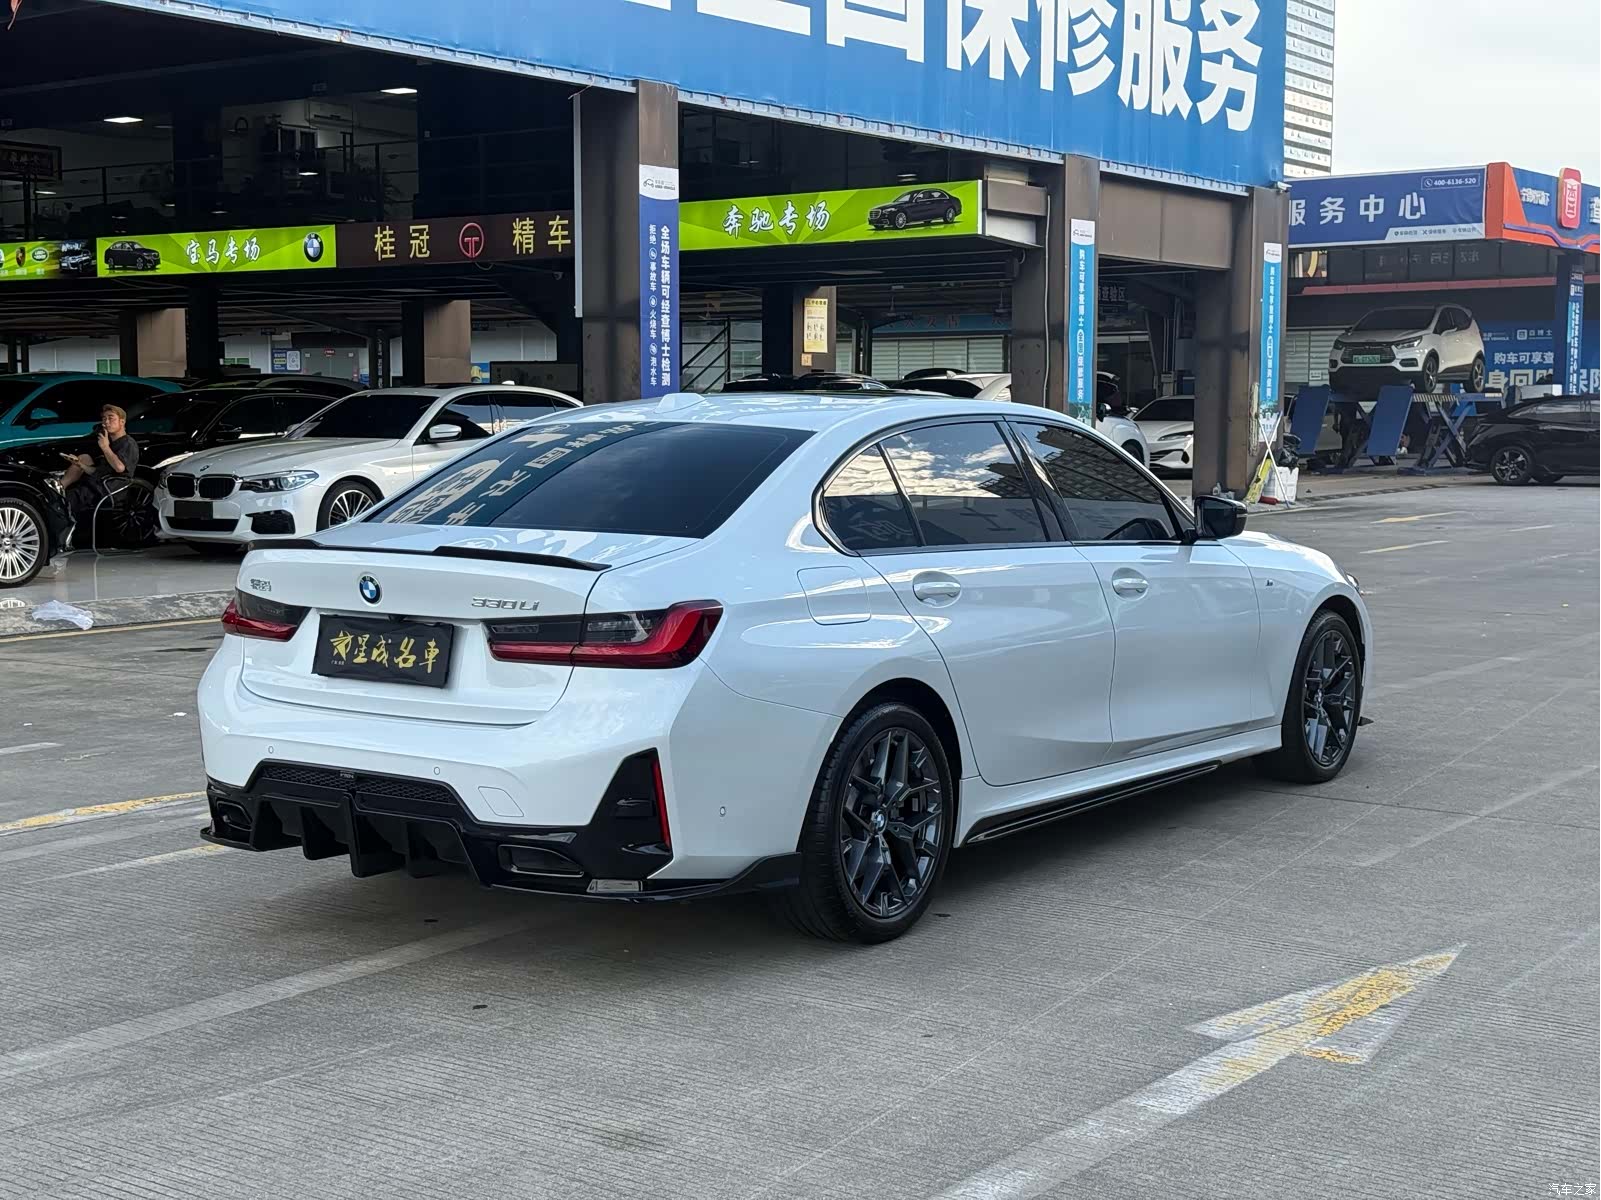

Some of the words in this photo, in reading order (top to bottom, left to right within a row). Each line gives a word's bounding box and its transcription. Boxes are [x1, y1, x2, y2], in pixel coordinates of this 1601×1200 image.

[1434, 178, 1476, 186] 400-6136-520
[723, 200, 831, 239] 奔驰专场
[1289, 192, 1426, 226] 服务中心
[186, 236, 260, 265] 宝马专场
[374, 225, 431, 261] 桂冠
[512, 215, 571, 255] 精车
[649, 261, 657, 292] 事故车
[660, 225, 671, 387] 全场车辆可经查博士检测
